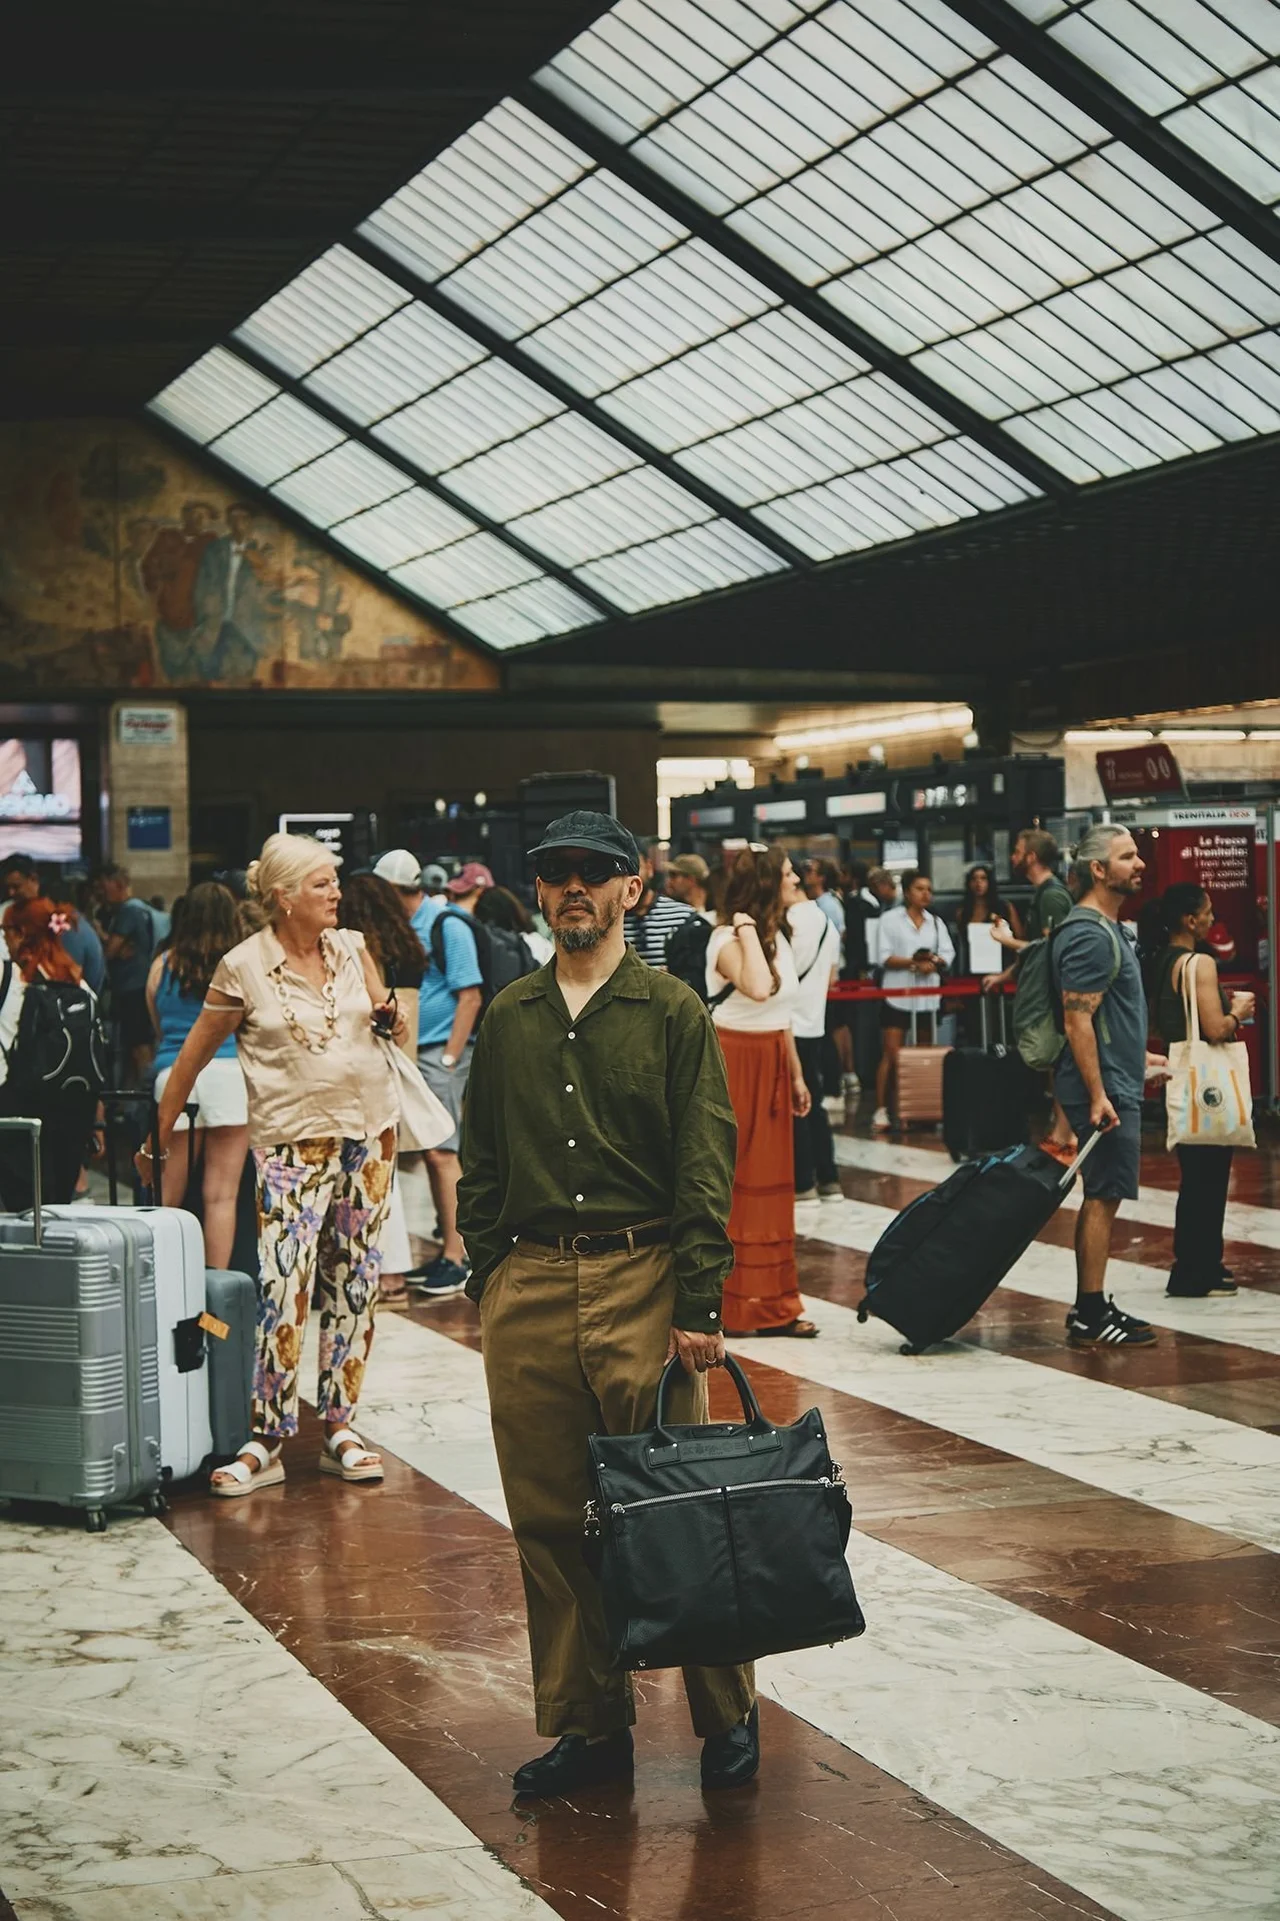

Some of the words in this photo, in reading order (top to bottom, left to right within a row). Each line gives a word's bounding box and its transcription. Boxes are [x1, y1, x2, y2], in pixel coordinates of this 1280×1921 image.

[1174, 811, 1227, 819] TRENITALIA
[1199, 835, 1212, 846] Le
[1214, 835, 1247, 845] Frecce
[1181, 847, 1192, 858] di
